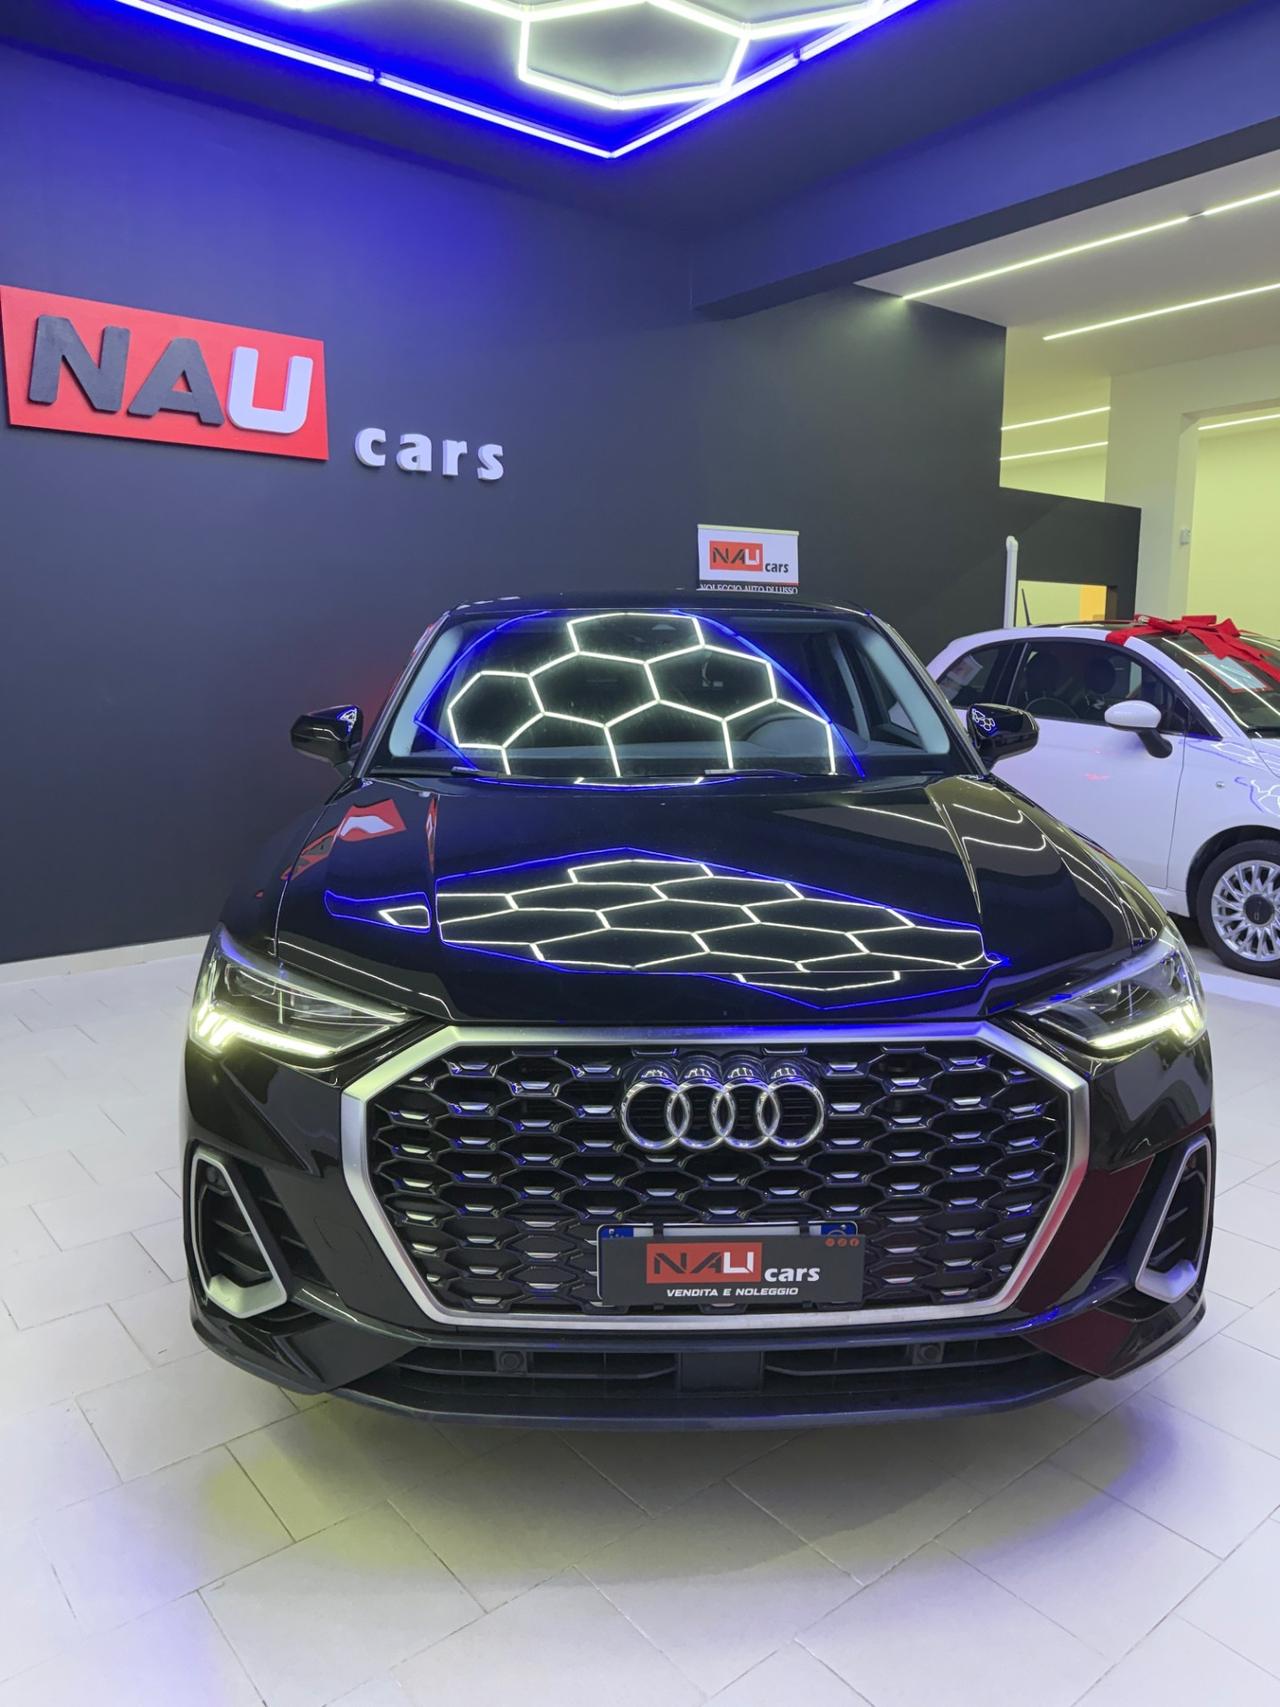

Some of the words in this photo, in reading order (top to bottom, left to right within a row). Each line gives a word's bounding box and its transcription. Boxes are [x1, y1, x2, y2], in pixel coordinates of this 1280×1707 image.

[28, 314, 313, 434] NAU
[355, 427, 504, 481] cars
[713, 547, 760, 565] NAU
[765, 563, 789, 573] cars
[654, 1251, 754, 1275] NAU
[764, 1267, 820, 1282] cars
[666, 1287, 718, 1297] VENDITA
[723, 1288, 731, 1296] E
[735, 1287, 799, 1296] NOLEGGIO
